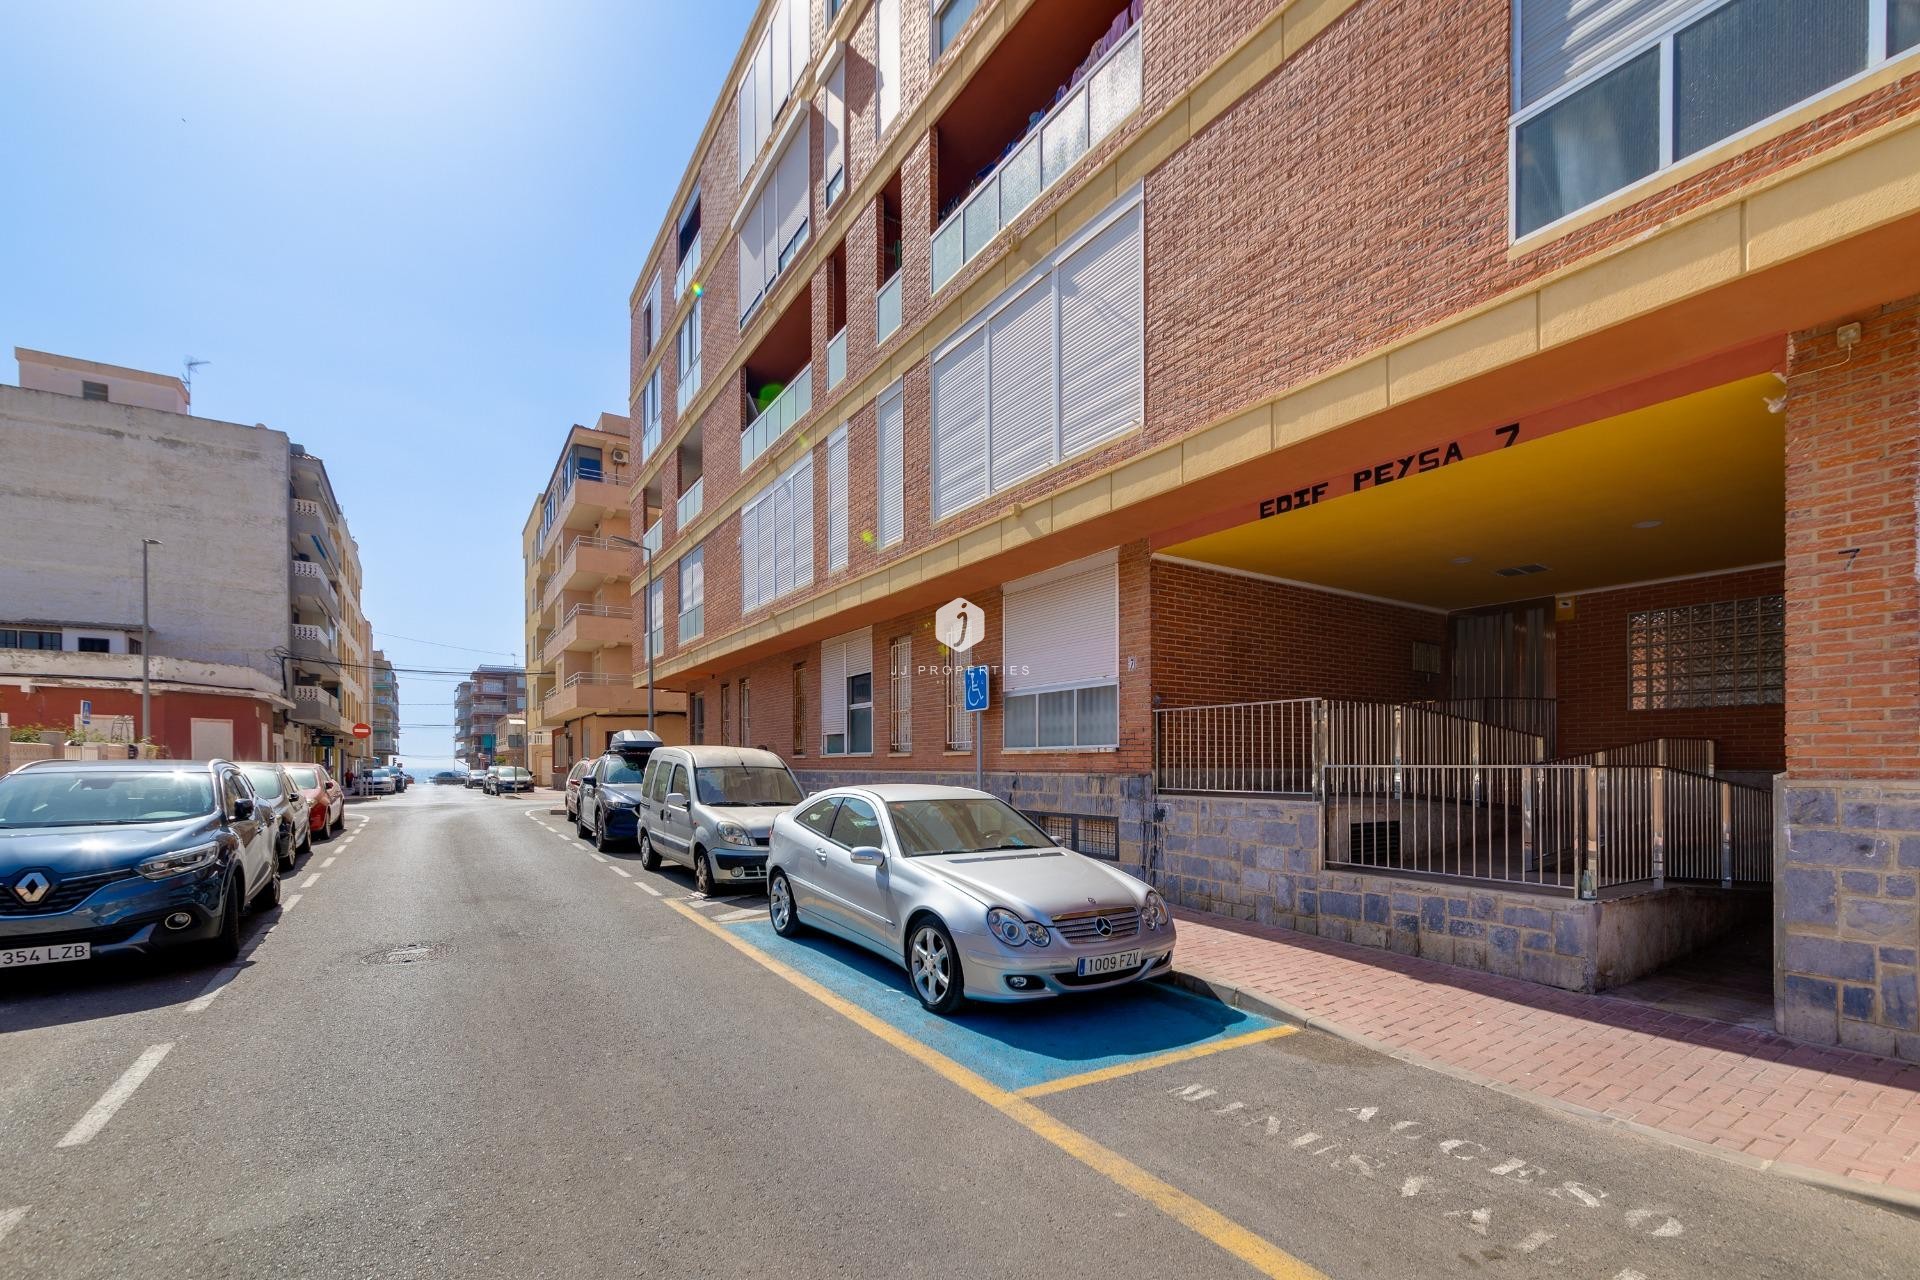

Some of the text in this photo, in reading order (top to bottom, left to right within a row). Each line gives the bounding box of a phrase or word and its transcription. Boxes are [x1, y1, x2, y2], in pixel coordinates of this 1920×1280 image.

[1259, 422, 1520, 520] EDIF PEYSA 7
[1838, 548, 1860, 571] 7
[48, 945, 86, 960] LZB
[1089, 951, 1139, 973] 1009 FZV
